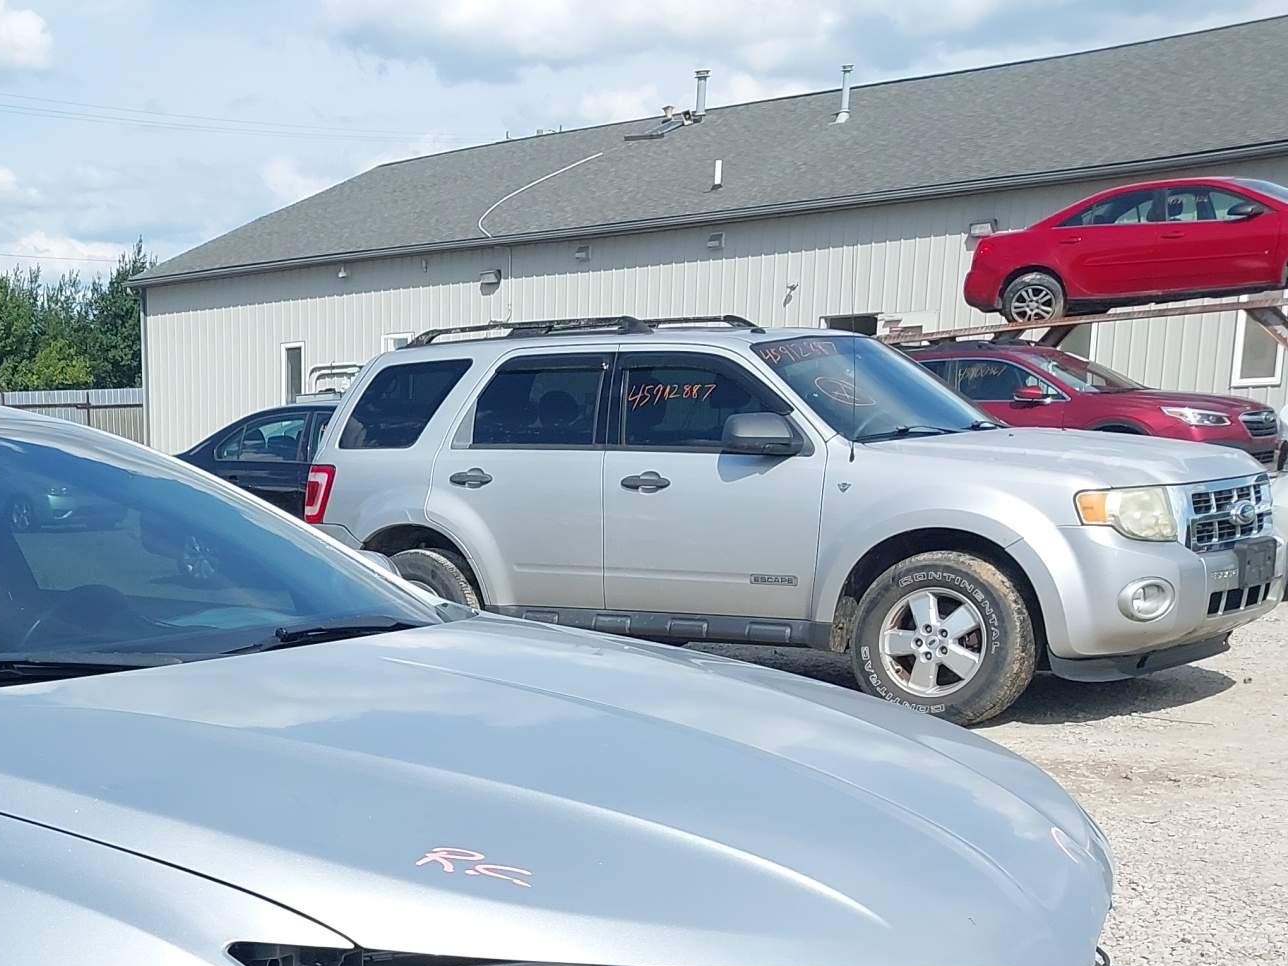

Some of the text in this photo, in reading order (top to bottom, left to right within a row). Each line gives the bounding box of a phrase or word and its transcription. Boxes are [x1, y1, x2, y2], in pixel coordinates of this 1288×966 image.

[627, 383, 717, 411] 45912887
[753, 575, 794, 585] ESCAPE
[898, 571, 1001, 655] CONTINENTAL
